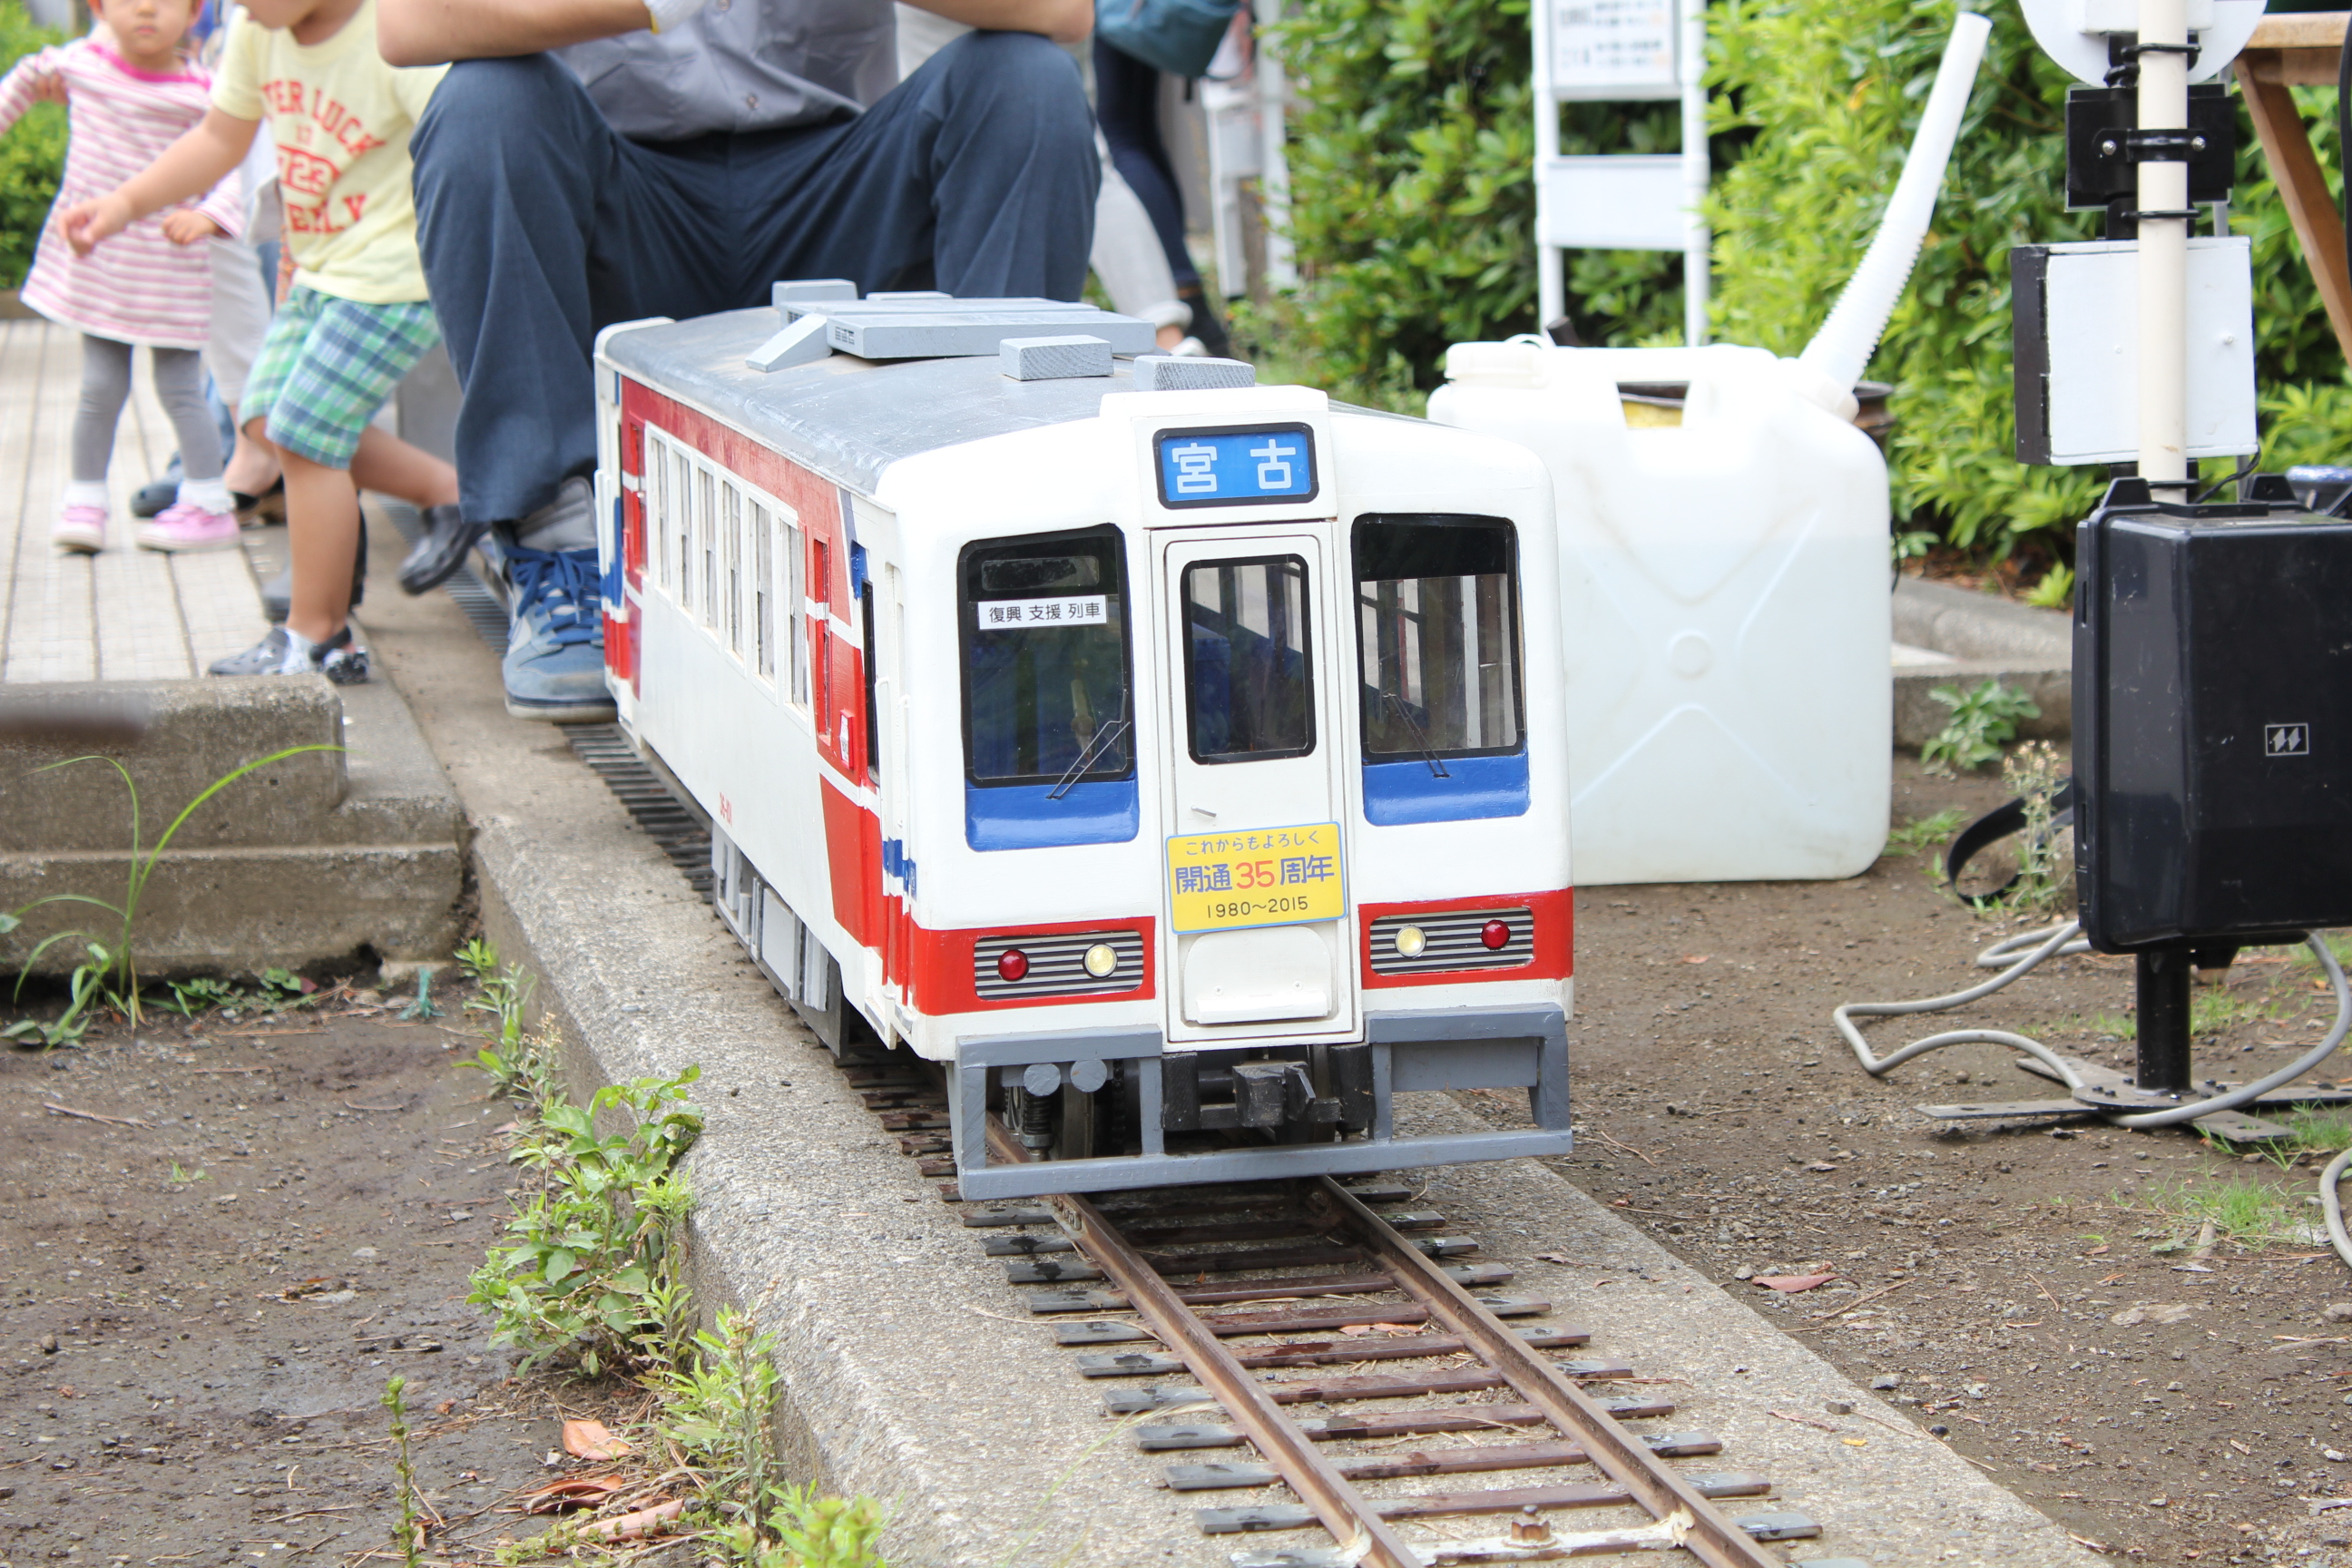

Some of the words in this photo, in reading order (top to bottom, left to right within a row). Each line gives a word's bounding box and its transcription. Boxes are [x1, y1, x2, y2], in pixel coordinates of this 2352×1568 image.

[1171, 439, 1297, 494] 宮古
[989, 606, 1022, 623] 復興
[1028, 603, 1062, 622] 支援
[1068, 602, 1101, 619] 列車
[1186, 830, 1319, 856] これからもよろしく
[1175, 855, 1335, 895] 開通35周年
